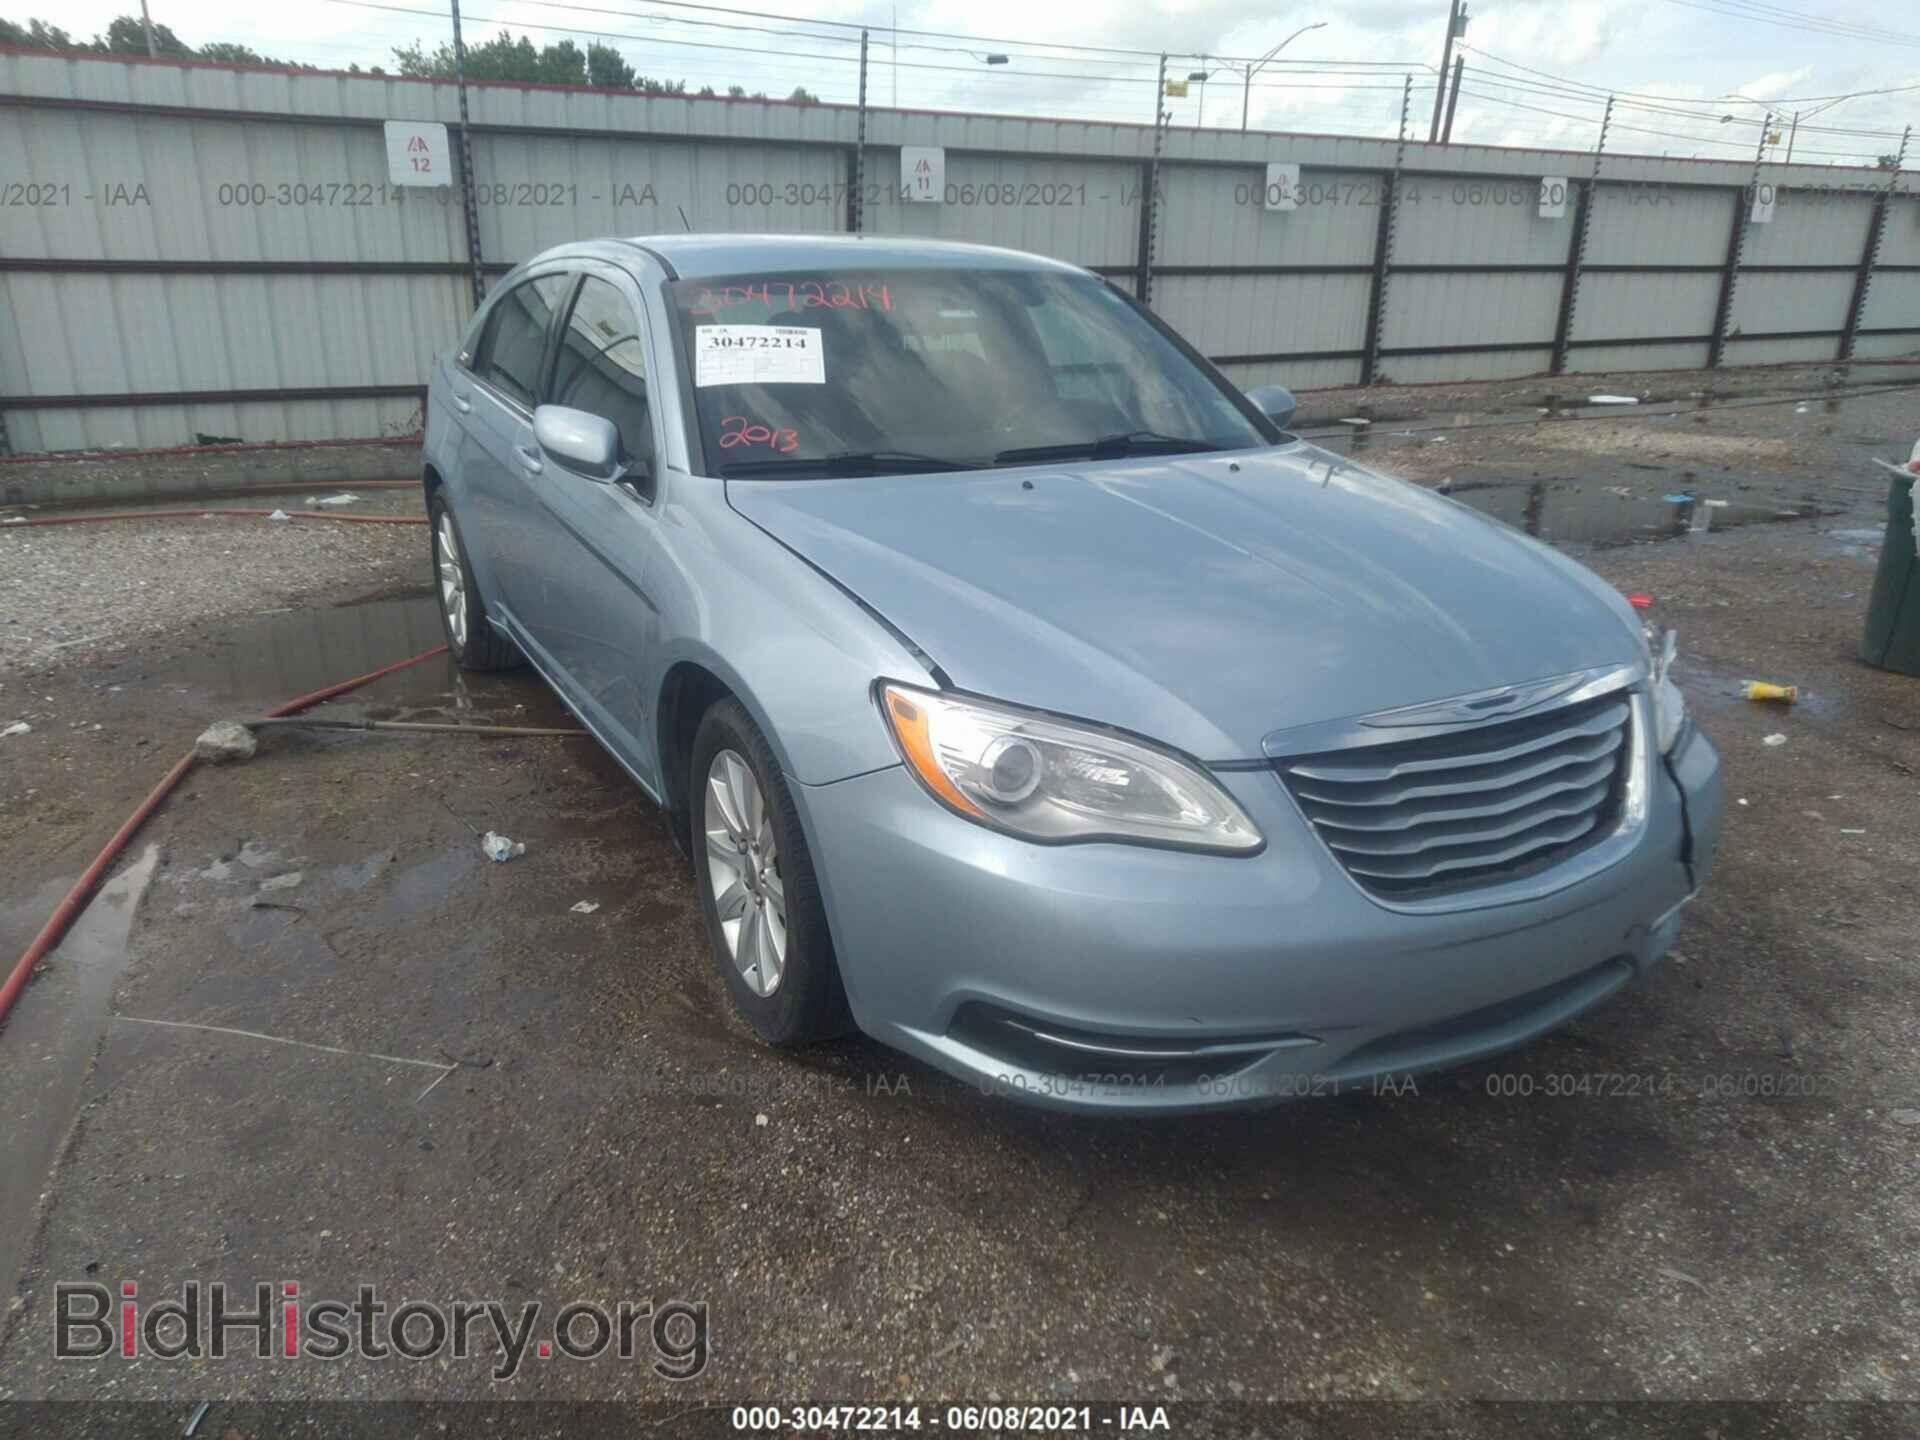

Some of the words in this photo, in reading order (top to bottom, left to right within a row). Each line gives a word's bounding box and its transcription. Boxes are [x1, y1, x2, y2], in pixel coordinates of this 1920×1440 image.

[410, 158, 431, 172] 12
[709, 336, 807, 349] 30472214
[719, 416, 800, 452] 2013
